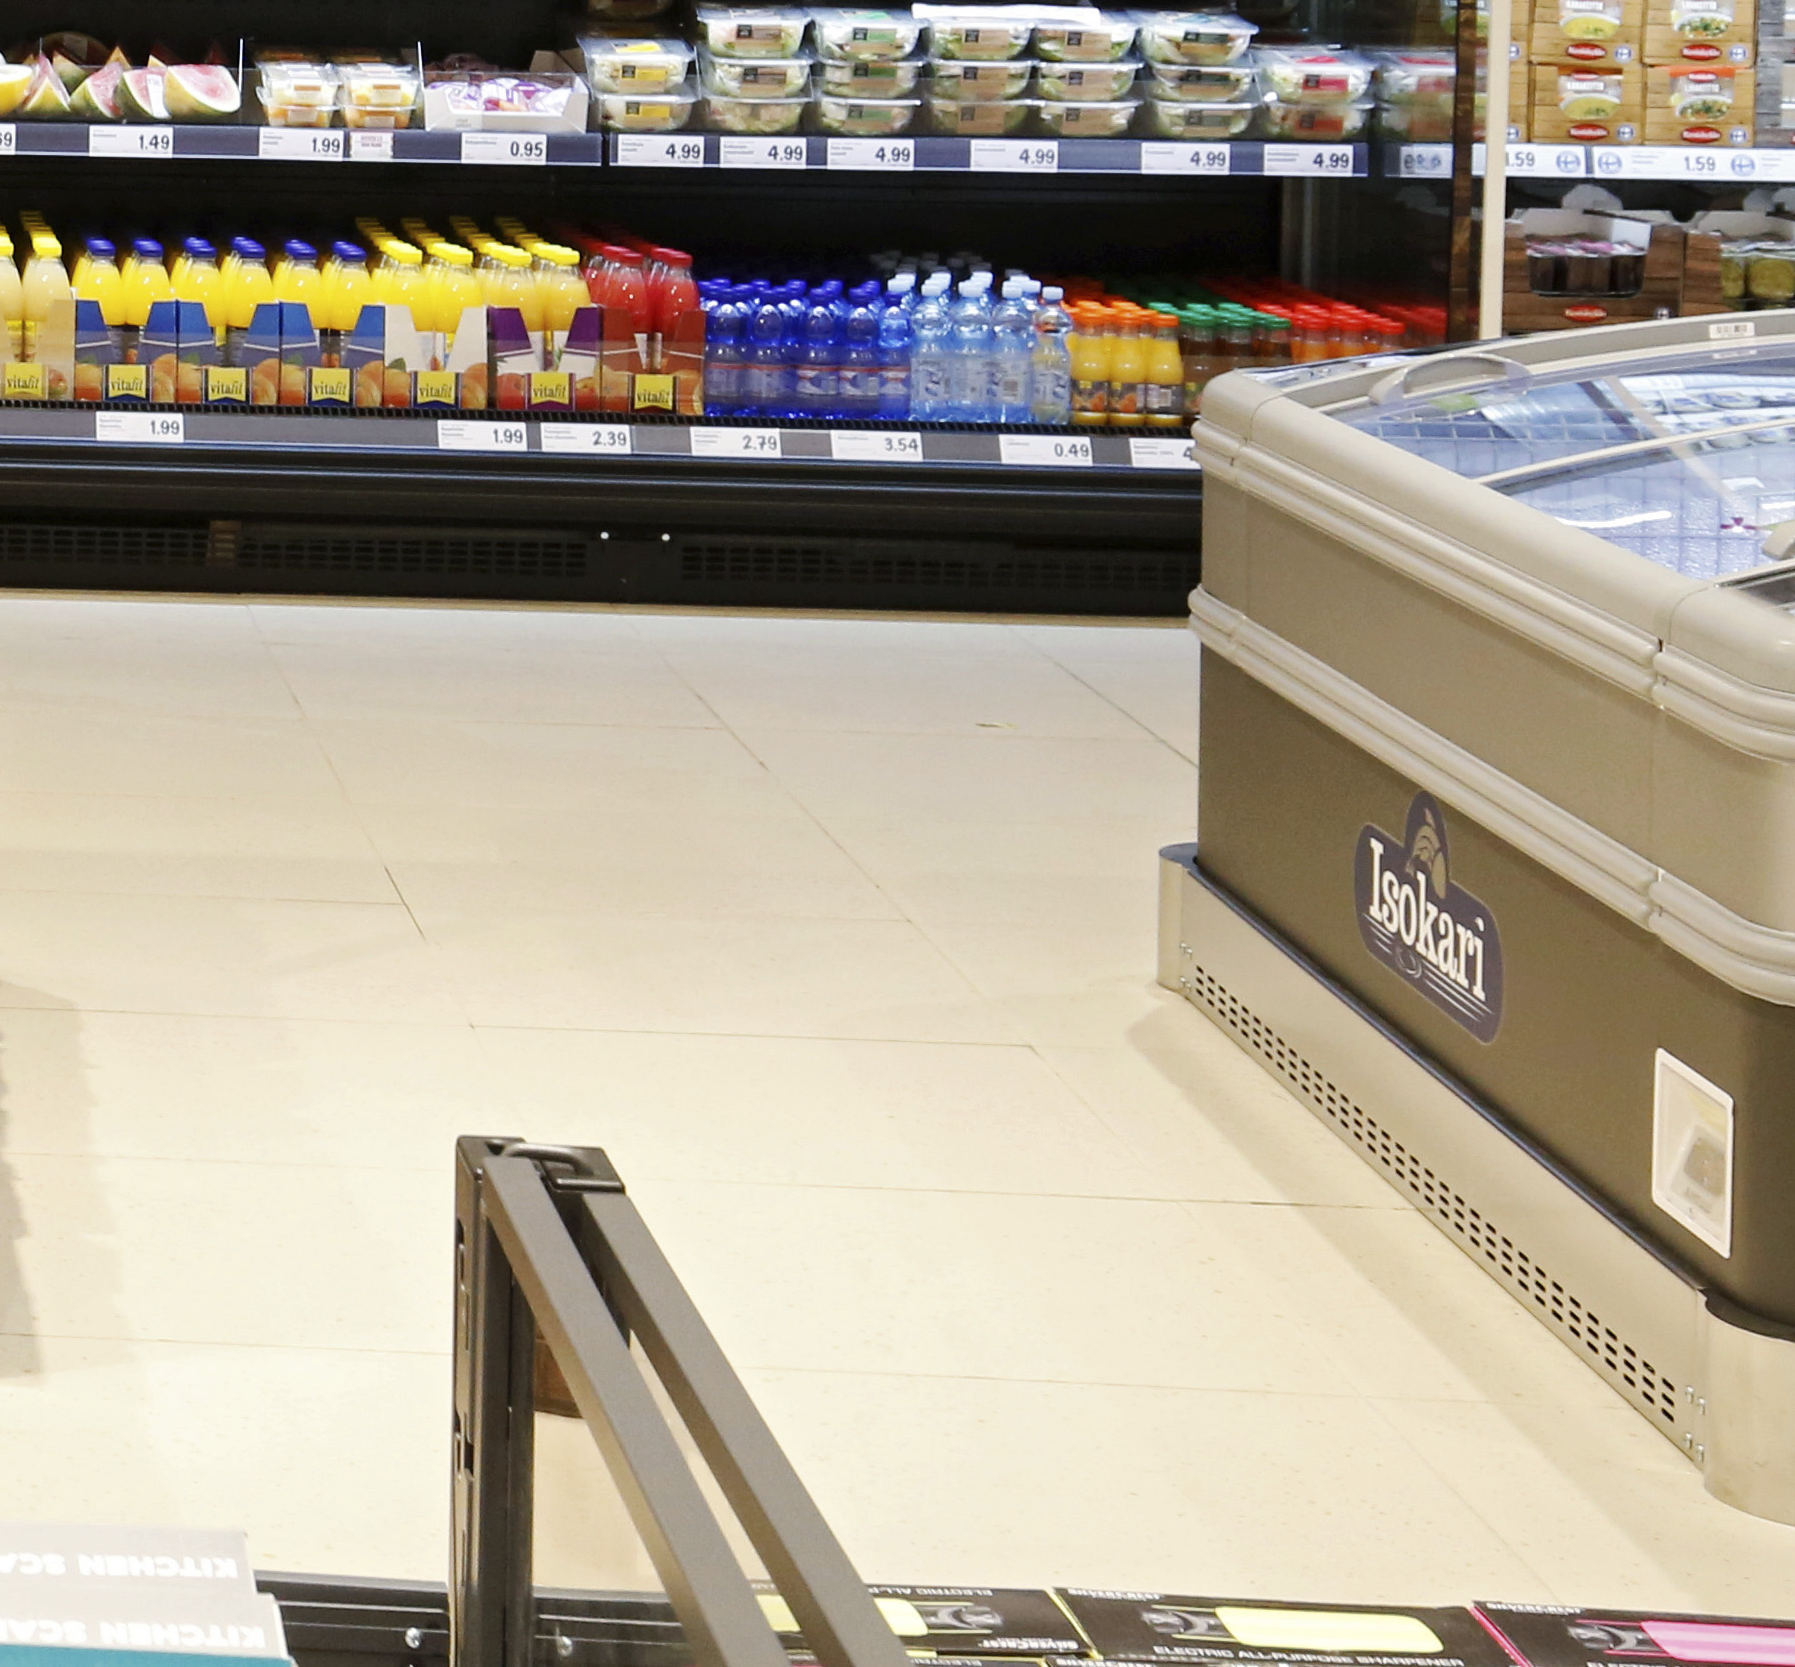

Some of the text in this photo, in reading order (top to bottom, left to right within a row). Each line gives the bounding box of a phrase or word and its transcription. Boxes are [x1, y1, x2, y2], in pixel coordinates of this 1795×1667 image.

[139, 135, 170, 150] 1.49
[510, 141, 543, 156] 0.95
[665, 143, 701, 159] 4.99
[1684, 155, 1716, 171] 1.59
[110, 379, 144, 392] vitafit
[419, 385, 453, 398] vitafit
[150, 420, 180, 435] 1.99
[592, 431, 627, 446] 2.39
[884, 438, 918, 452] 3.54
[1054, 443, 1089, 458] 0.49
[1367, 837, 1486, 1002] Isokari
[1153, 1645, 1235, 1657] ELECTRIC
[1237, 1649, 1353, 1662] ALL-PURPOSE
